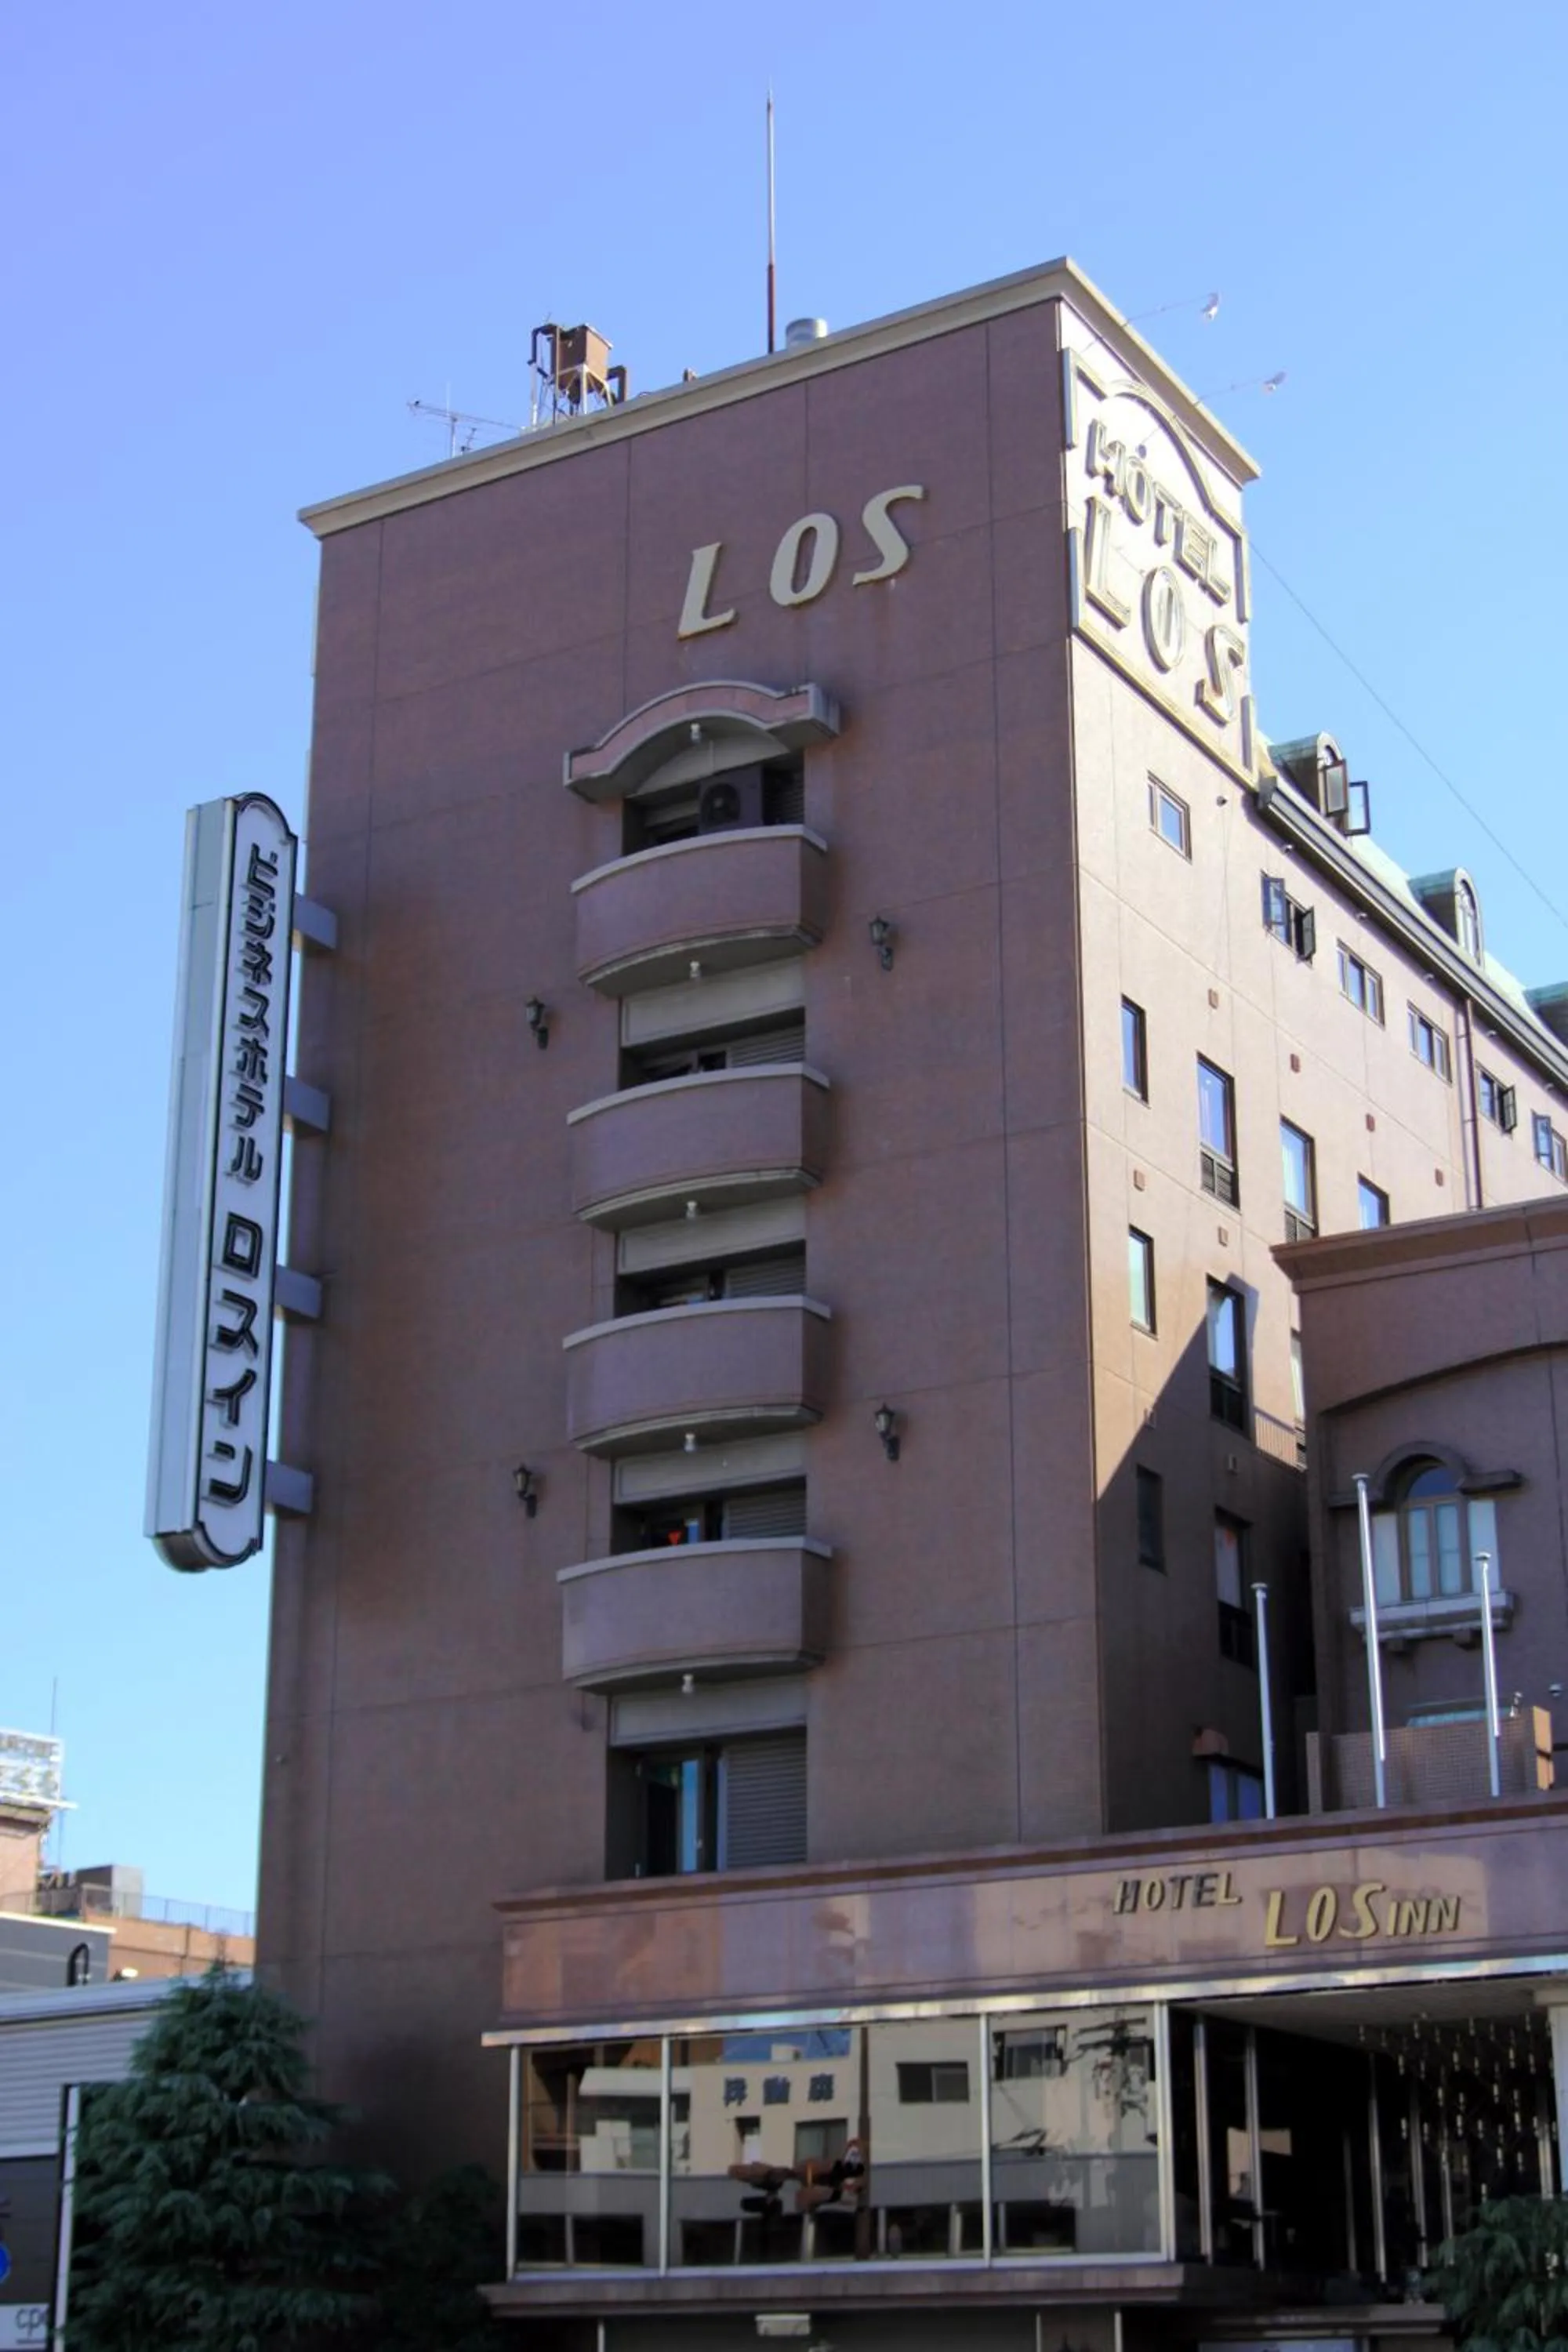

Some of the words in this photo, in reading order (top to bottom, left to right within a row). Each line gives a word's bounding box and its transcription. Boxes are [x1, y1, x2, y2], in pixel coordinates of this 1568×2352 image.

[677, 485, 924, 641] LOS
[1084, 495, 1245, 726] LOS
[1085, 418, 1231, 606] HOTEL
[229, 841, 278, 1182] ビジネスホテル
[208, 1211, 263, 1505] ロスイン
[1113, 1871, 1243, 1915] HOTEL
